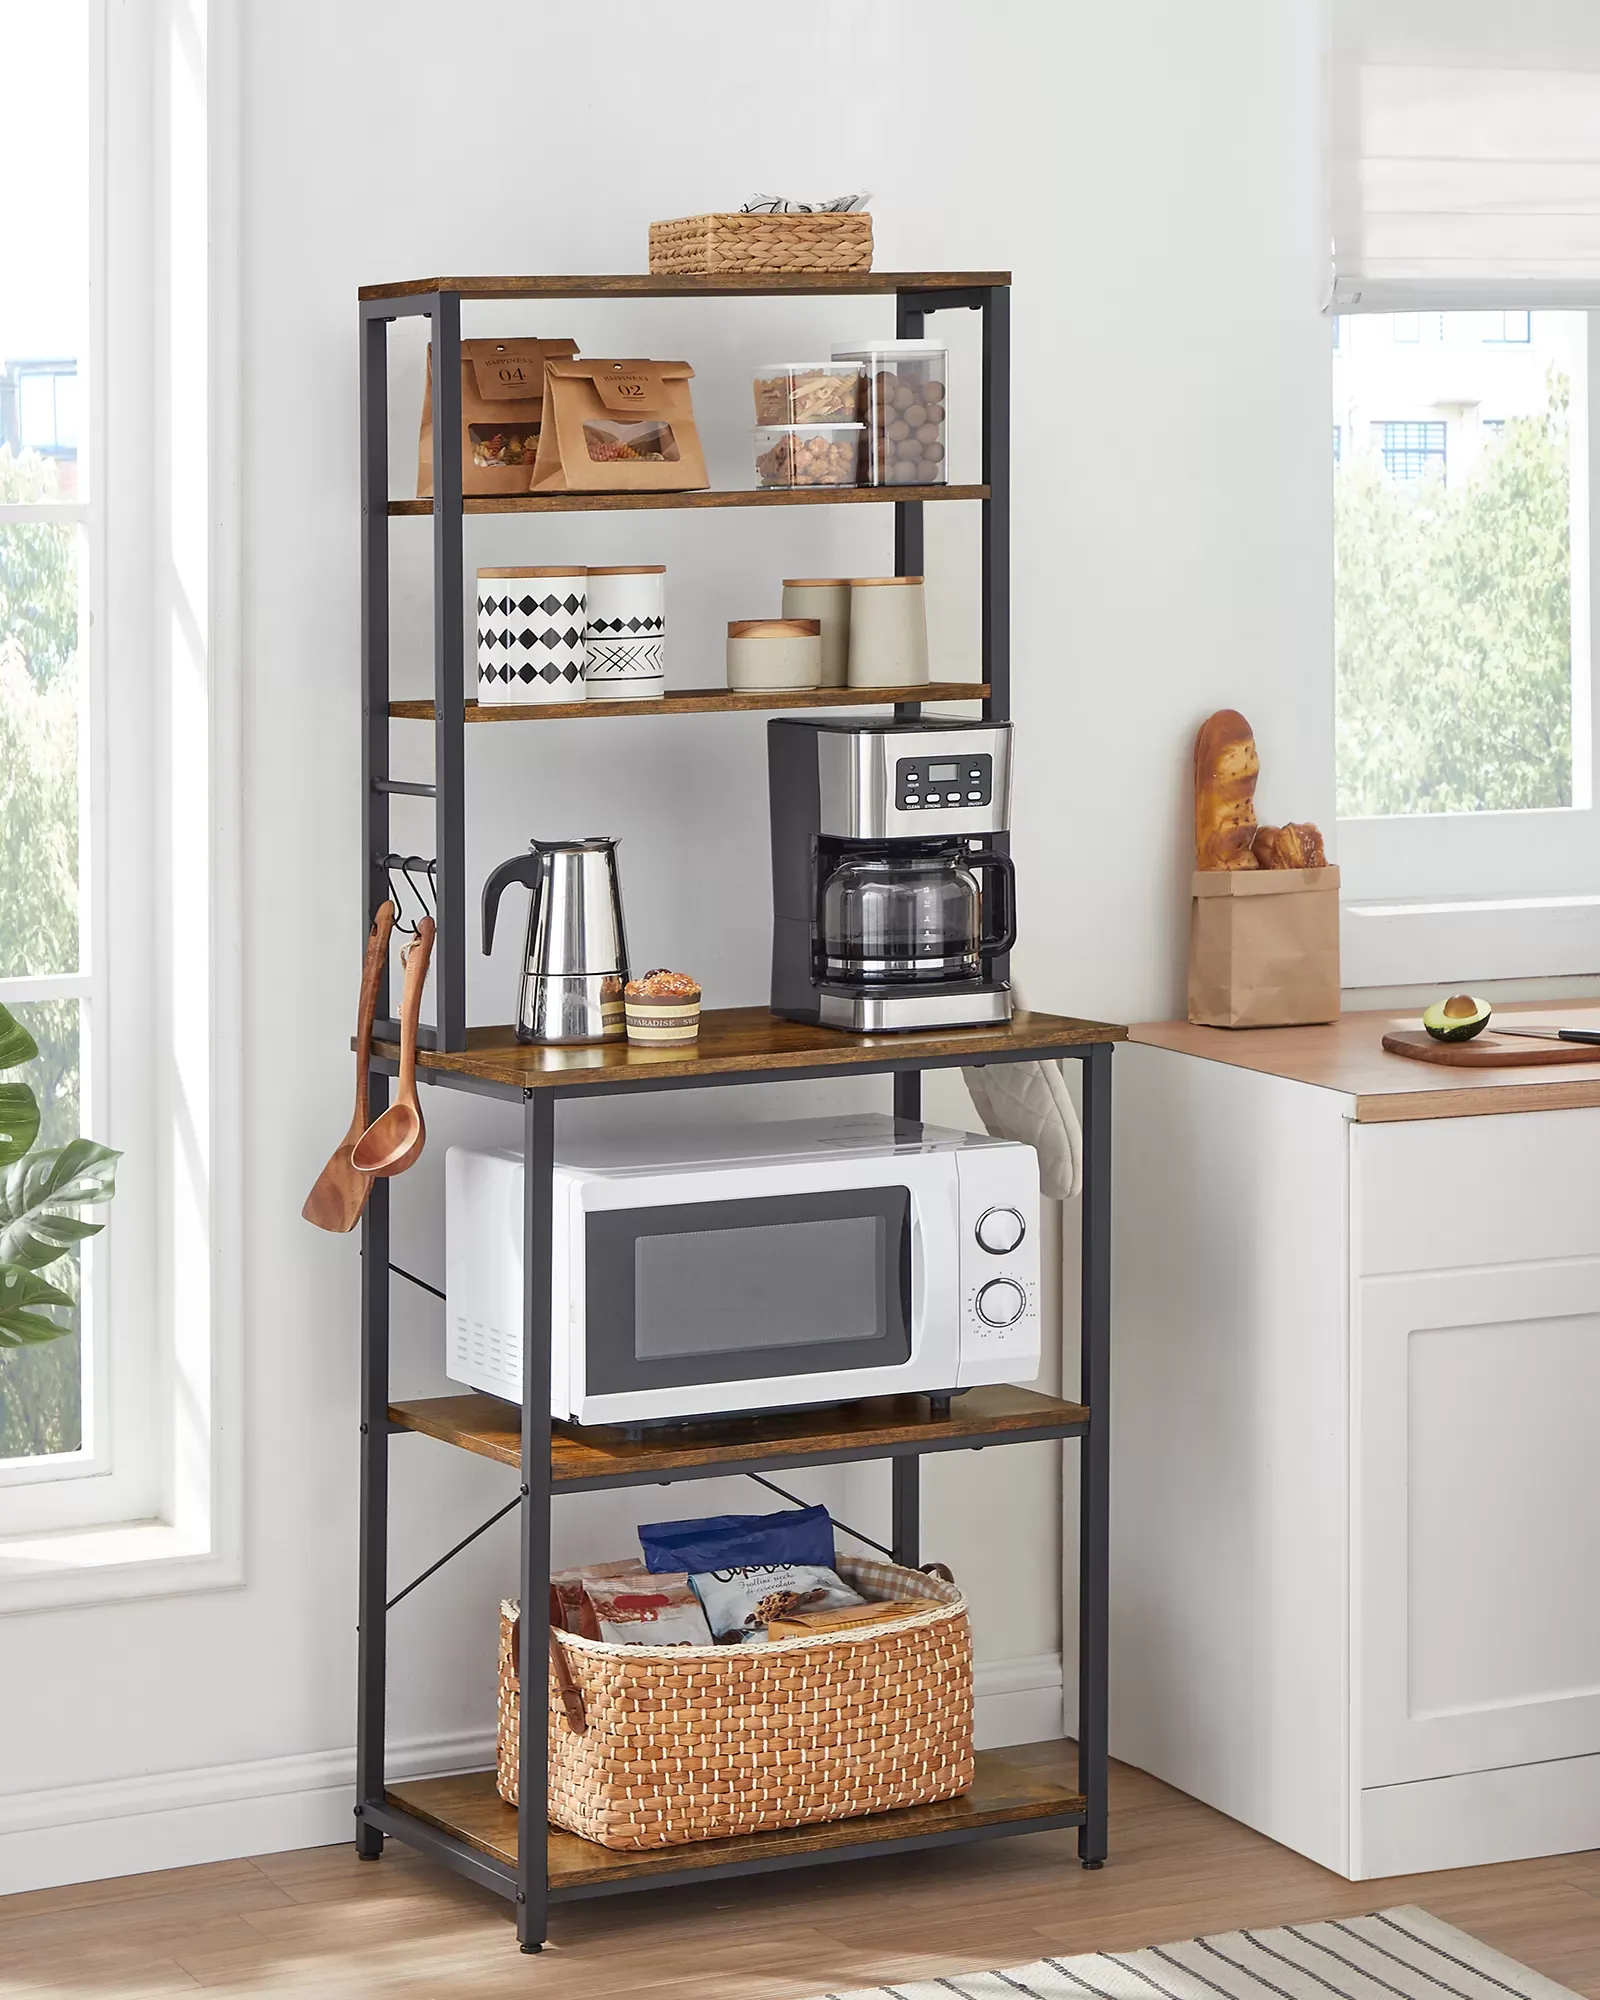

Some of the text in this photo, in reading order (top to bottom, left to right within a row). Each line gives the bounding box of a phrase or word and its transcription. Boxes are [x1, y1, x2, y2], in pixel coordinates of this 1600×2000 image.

[484, 357, 533, 367] HAPPINESS
[498, 367, 526, 382] 04
[617, 384, 644, 396] 02
[633, 1018, 675, 1027] PARADISE
[745, 1586, 754, 1595] di
